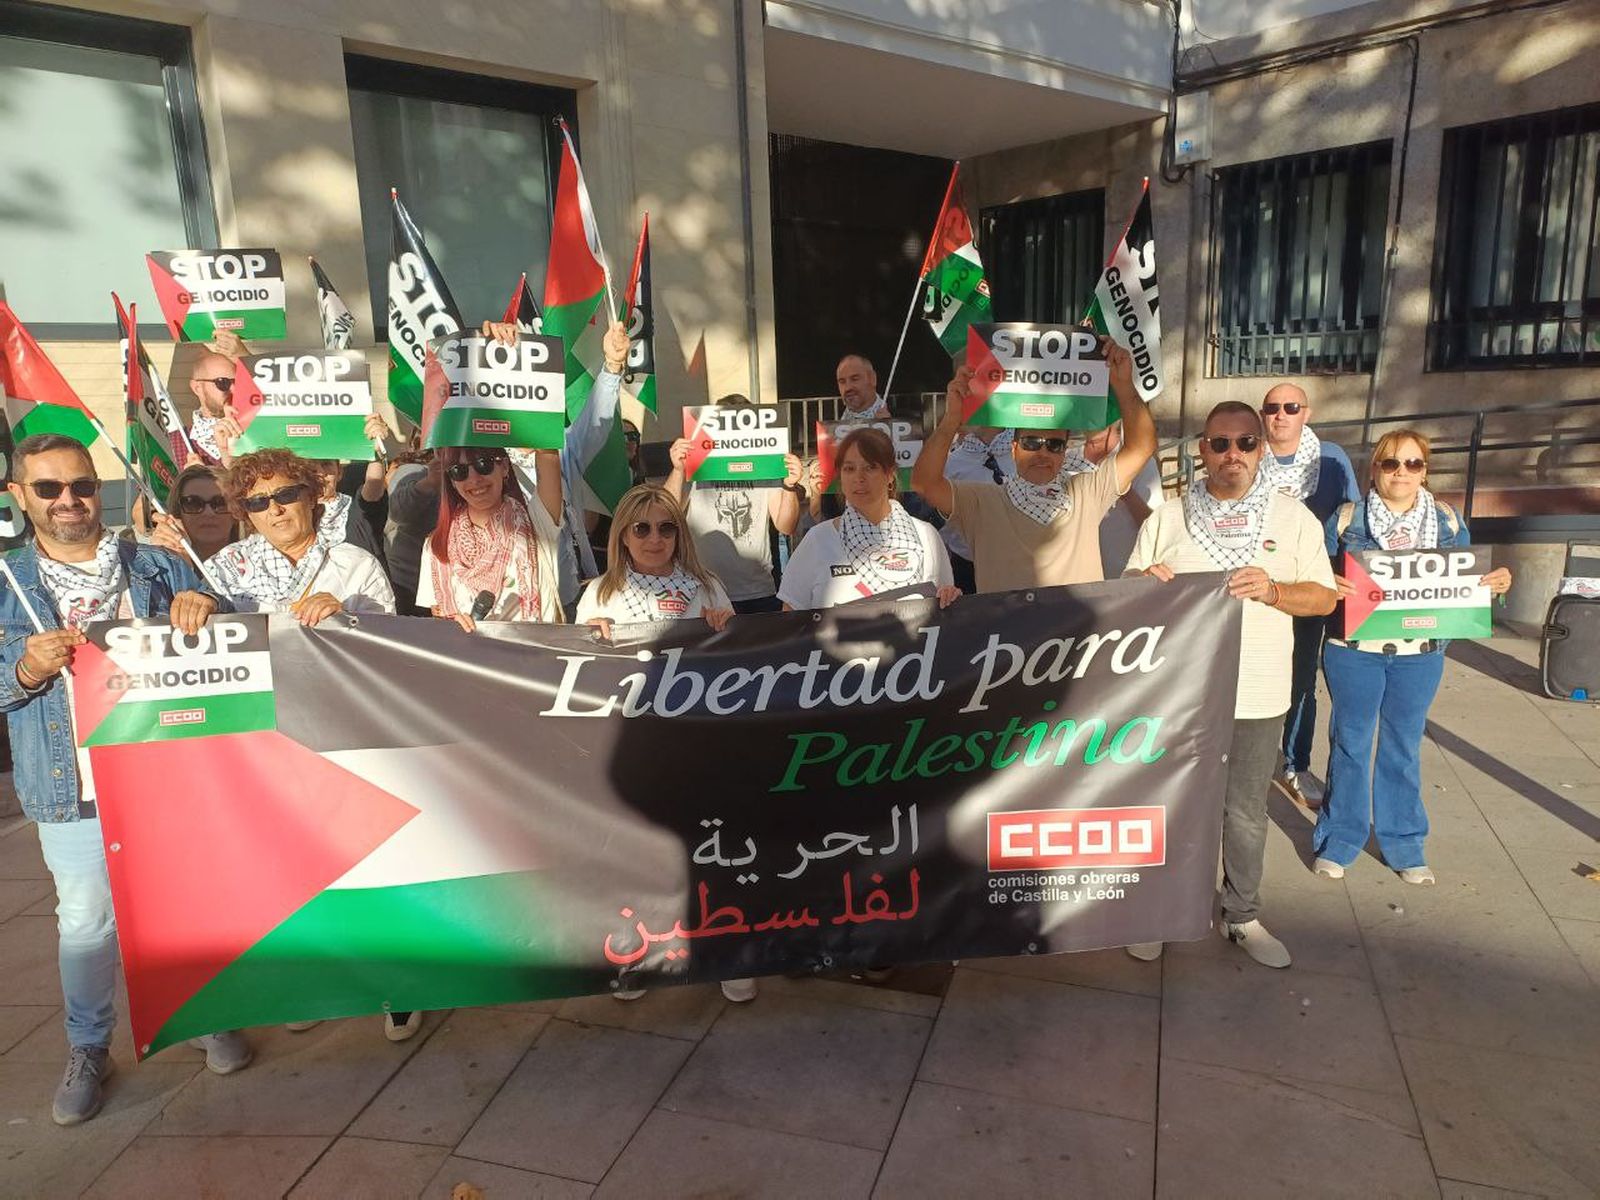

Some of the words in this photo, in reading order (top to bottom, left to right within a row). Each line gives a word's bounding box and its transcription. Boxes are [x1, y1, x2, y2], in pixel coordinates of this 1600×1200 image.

[169, 254, 266, 280] STOP
[399, 252, 460, 338] STO
[1104, 266, 1158, 391] GENOCIDIO
[440, 337, 549, 372] STOP
[991, 329, 1097, 360] STOP
[254, 355, 351, 383] STOP
[988, 369, 1092, 386] GENOCIDIO
[249, 393, 353, 407] GENOCIDIO
[439, 381, 548, 400] GENOCIDIO
[288, 426, 319, 435] CCOO
[475, 421, 509, 431] CCOO
[700, 408, 777, 431] STOP
[701, 437, 777, 450] GENOCIDIO
[1216, 517, 1247, 527] CCOO
[832, 567, 854, 576] NO
[1369, 552, 1476, 579] STOP
[1368, 586, 1473, 602] GENOCIDIO
[105, 621, 248, 659] STOP
[106, 665, 250, 691] GENOCIDIO
[539, 625, 945, 718] Libertad
[958, 625, 1167, 714] para
[161, 711, 203, 724] CCOO
[768, 700, 1167, 792] Palestina
[1000, 819, 1153, 858] CCOO
[988, 872, 1076, 888] comisiones
[1080, 871, 1140, 885] obreras
[988, 890, 1008, 904] de
[1011, 887, 1070, 903] Castilla
[1074, 891, 1082, 903] y
[1086, 886, 1125, 901] León
